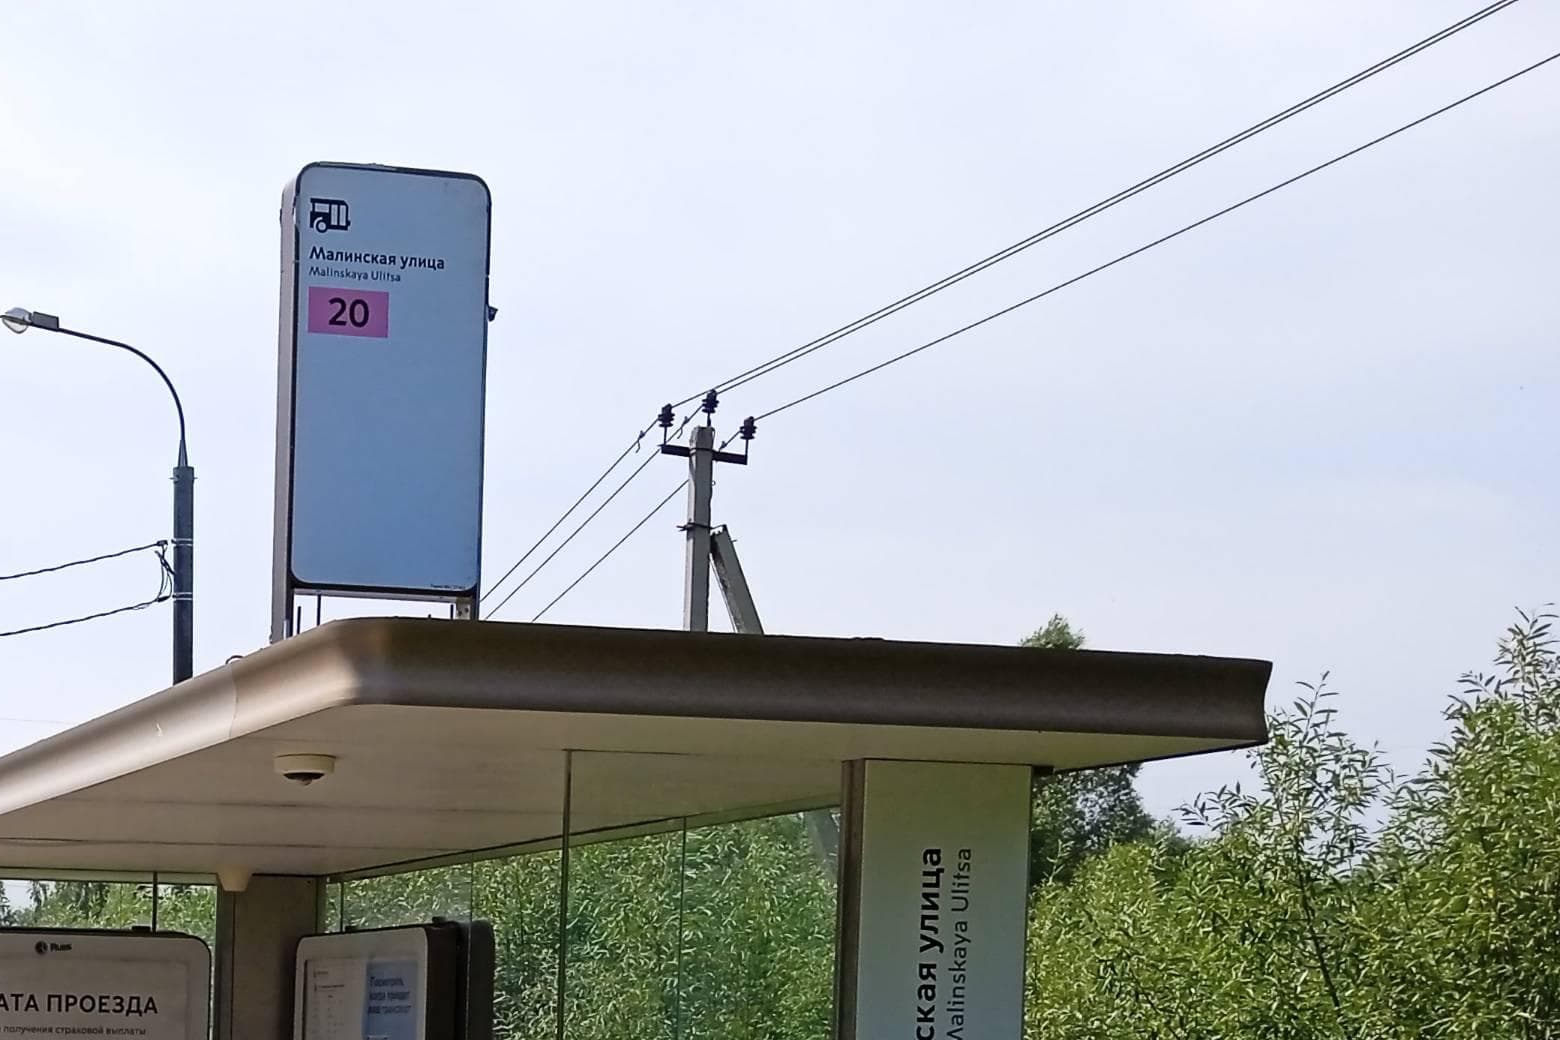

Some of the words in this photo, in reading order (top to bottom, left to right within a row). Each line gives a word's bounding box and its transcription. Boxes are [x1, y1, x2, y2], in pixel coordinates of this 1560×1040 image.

[309, 246, 397, 265] Малинская
[400, 255, 445, 270] улица
[308, 266, 369, 281] Malinskaya
[370, 271, 401, 282] Ulitsa
[327, 296, 370, 328] 20
[950, 847, 972, 914] Ulitsa
[919, 847, 945, 954] улица
[46, 993, 159, 1017] ПРОЕЗДА
[3, 1026, 53, 1036] получения
